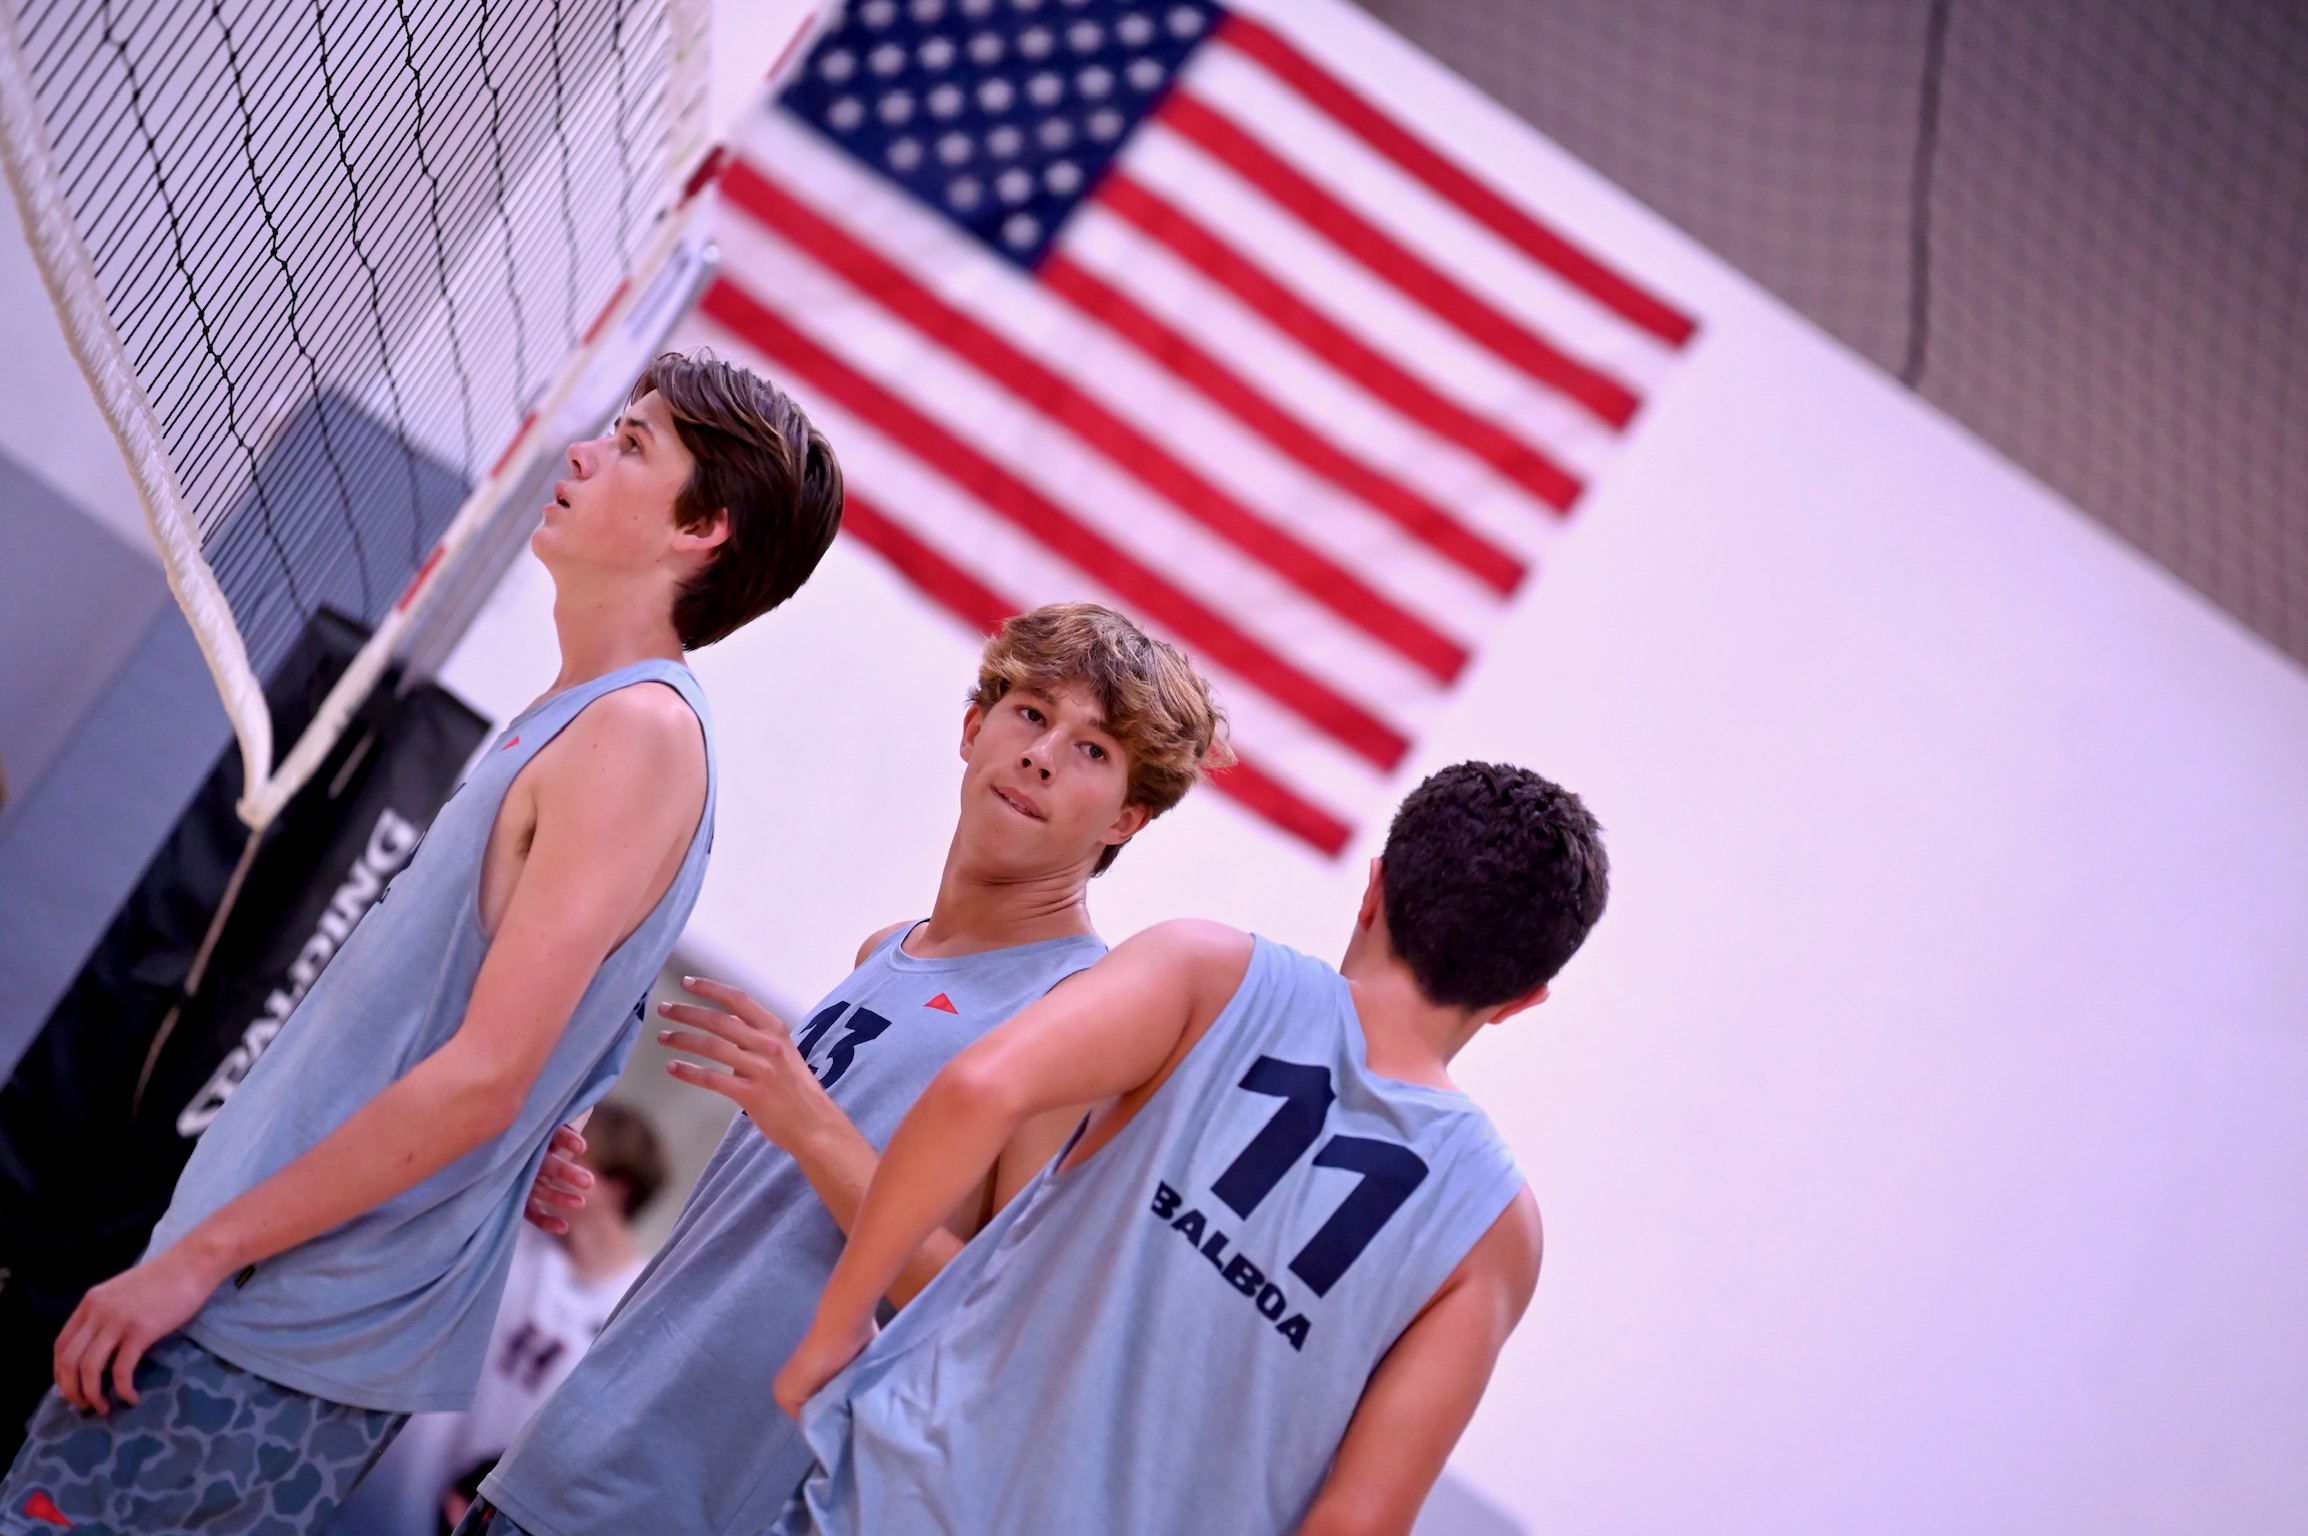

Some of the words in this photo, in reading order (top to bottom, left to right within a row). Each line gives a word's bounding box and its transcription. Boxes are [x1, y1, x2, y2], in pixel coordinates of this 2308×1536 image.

[797, 1000, 892, 1090] 13
[1210, 1055, 1429, 1299] 11
[1151, 1180, 1312, 1352] BALBOA
